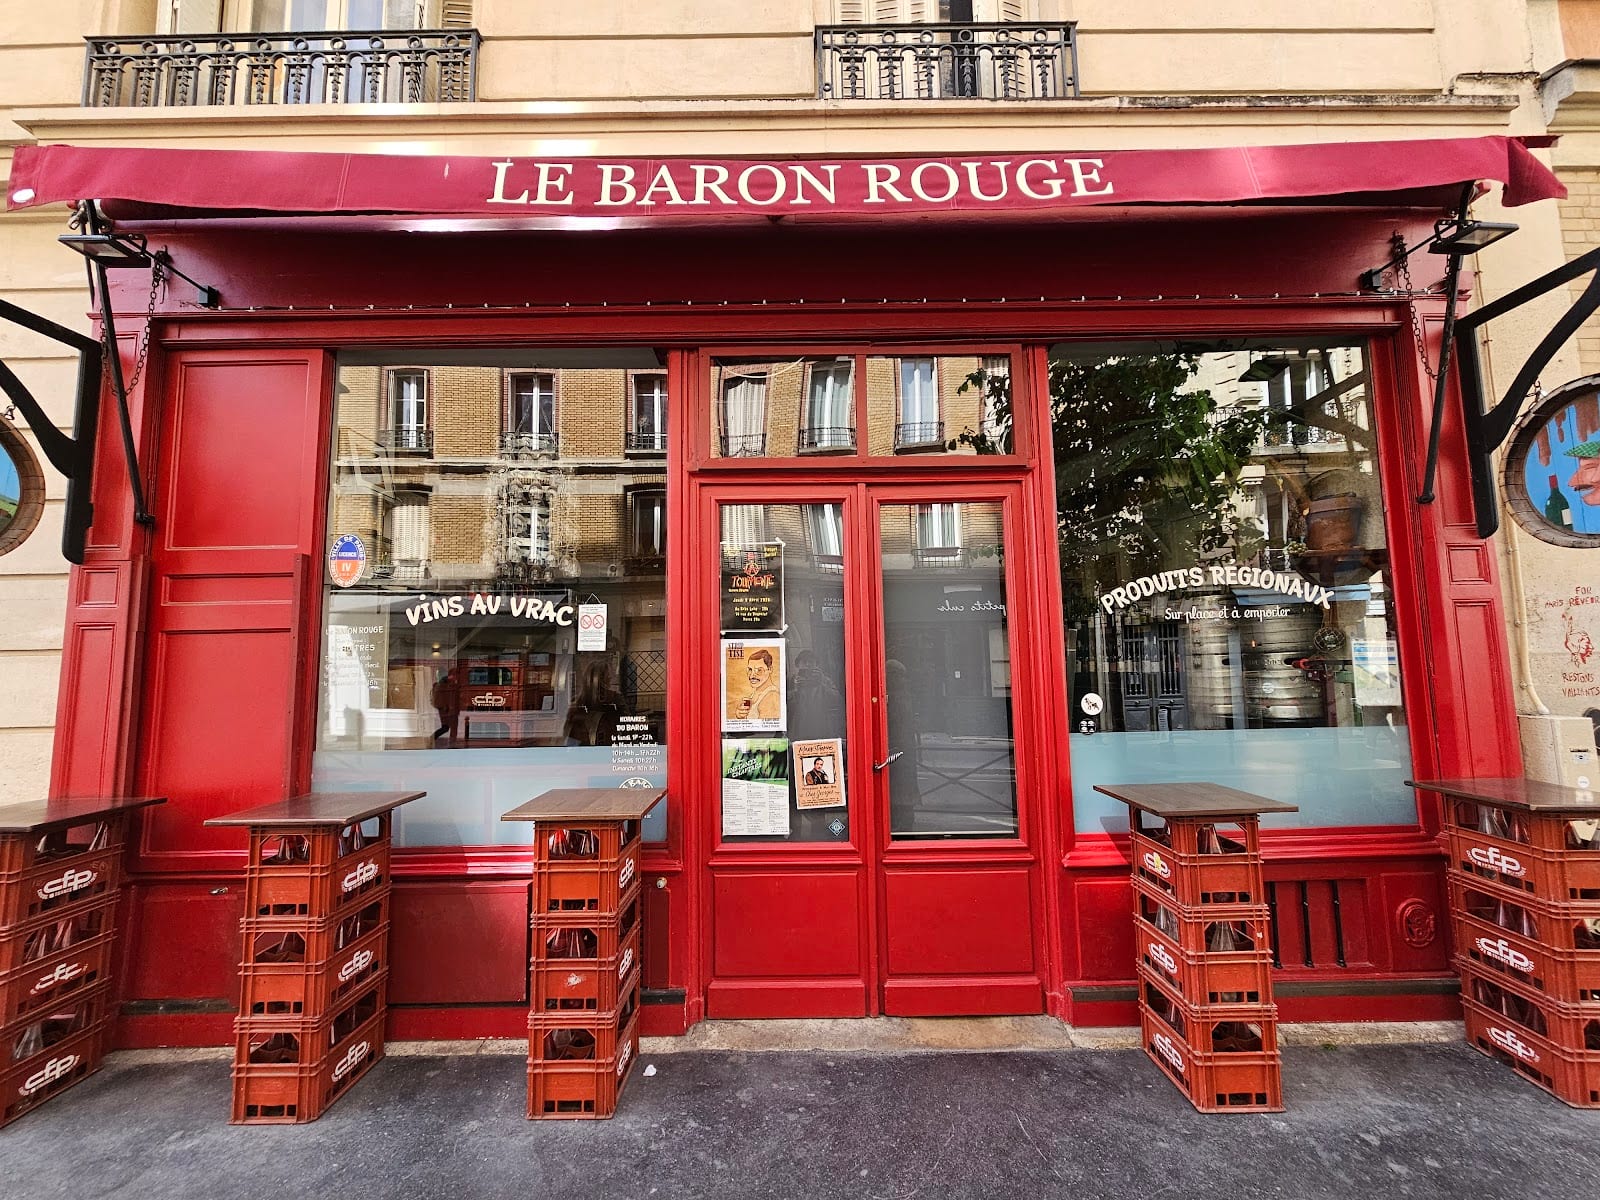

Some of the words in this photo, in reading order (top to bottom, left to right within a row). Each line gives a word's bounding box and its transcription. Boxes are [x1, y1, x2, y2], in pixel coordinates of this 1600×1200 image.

[486, 160, 574, 206] LE
[594, 163, 842, 207] BARON
[861, 158, 1114, 203] ROUGE
[341, 562, 352, 572] IV
[1100, 567, 1204, 614] PRODUITS
[1209, 559, 1335, 610] RÉGIONAUX
[470, 594, 502, 615] AU
[510, 597, 574, 626] VRAC
[1164, 607, 1183, 621] Sur
[1185, 606, 1216, 624] place
[1218, 606, 1229, 620] et
[1231, 605, 1241, 619] à
[1243, 606, 1291, 623] emporter
[359, 625, 384, 634] ROUGE
[474, 692, 504, 706] cfp
[616, 724, 626, 732] DU
[626, 724, 649, 732] BARON
[1471, 847, 1520, 873] cfp
[44, 869, 92, 891] cfp
[343, 862, 377, 888] cfp
[341, 950, 372, 976] cfp
[1150, 943, 1176, 971] cfp
[1480, 938, 1529, 967] cfp
[1490, 1027, 1535, 1057] cfp
[335, 1040, 368, 1076] cfp
[25, 1054, 76, 1089] cfp
